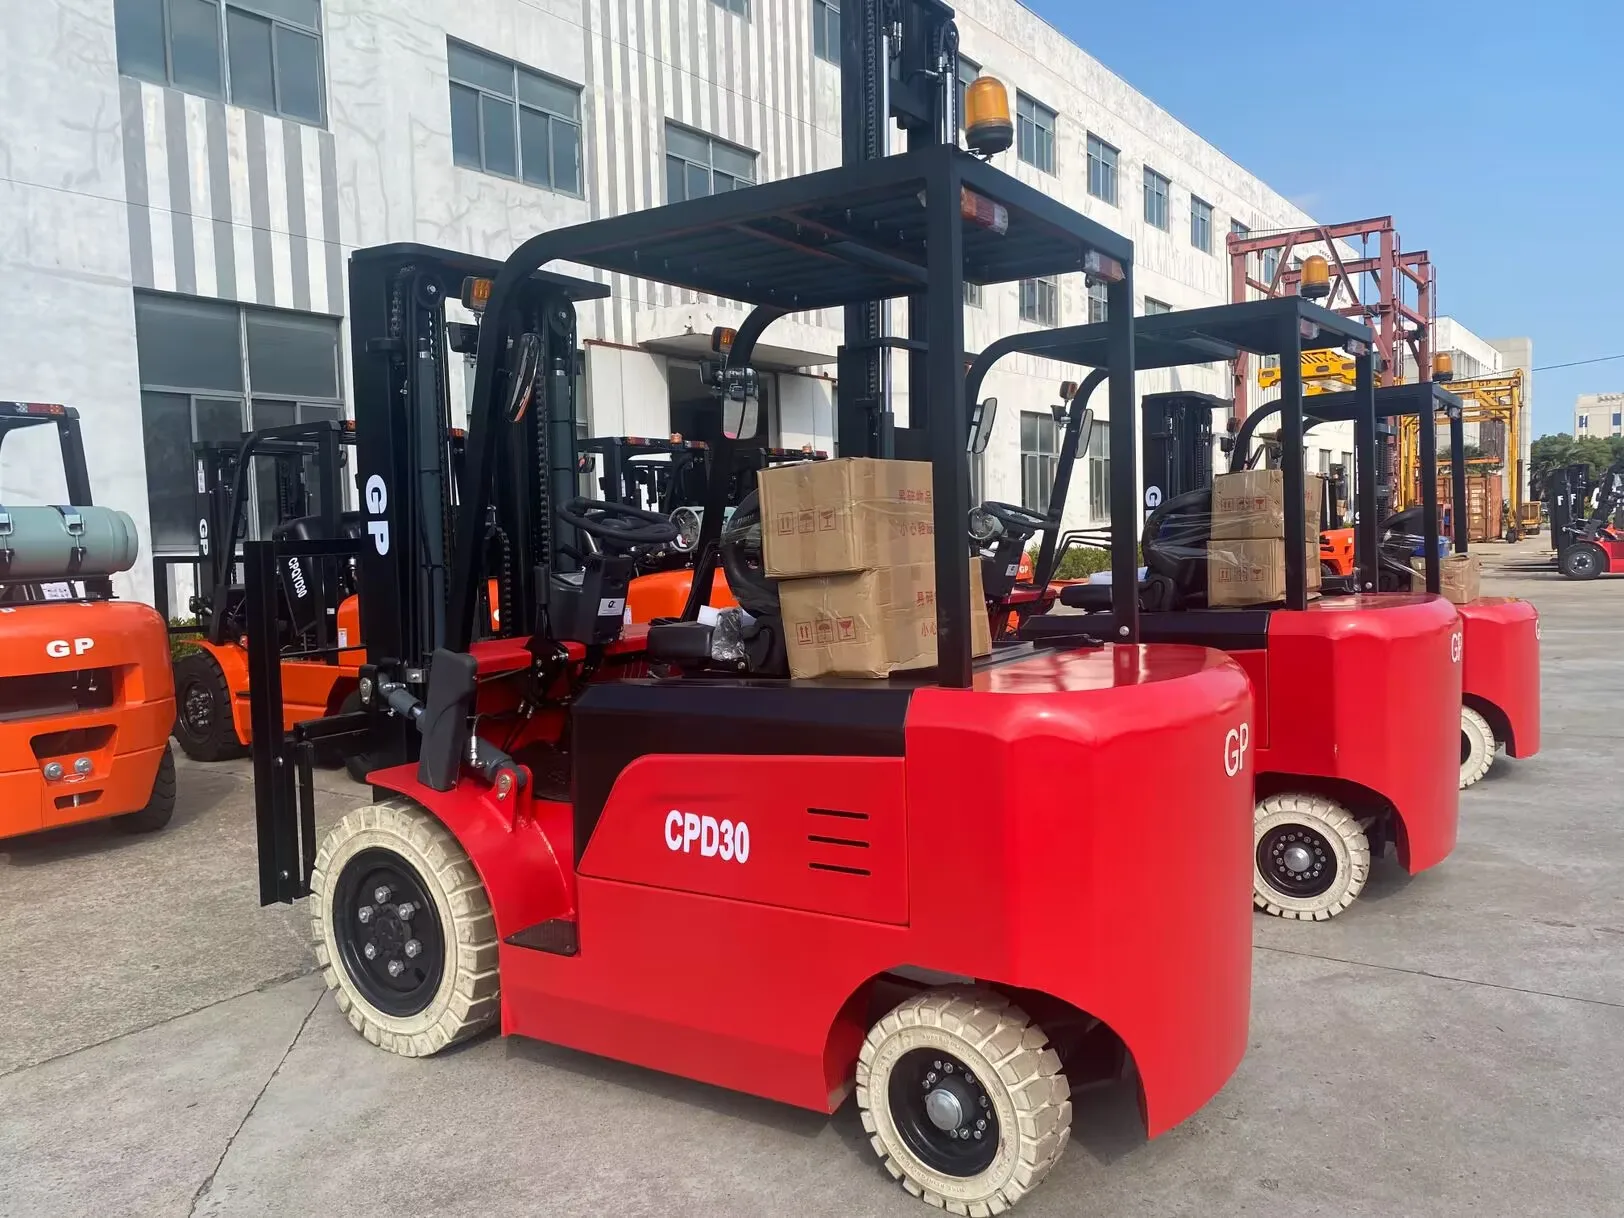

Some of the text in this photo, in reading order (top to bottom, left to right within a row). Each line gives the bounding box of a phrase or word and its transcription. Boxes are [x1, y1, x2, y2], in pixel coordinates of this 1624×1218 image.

[365, 474, 390, 556] GP
[1145, 485, 1162, 520] G
[199, 518, 209, 556] GP
[288, 557, 308, 598] CPQYD30
[1019, 565, 1029, 574] GP
[46, 637, 95, 658] GP
[1451, 631, 1463, 663] GP
[1223, 722, 1249, 777] GP
[664, 809, 750, 864] CPD30
